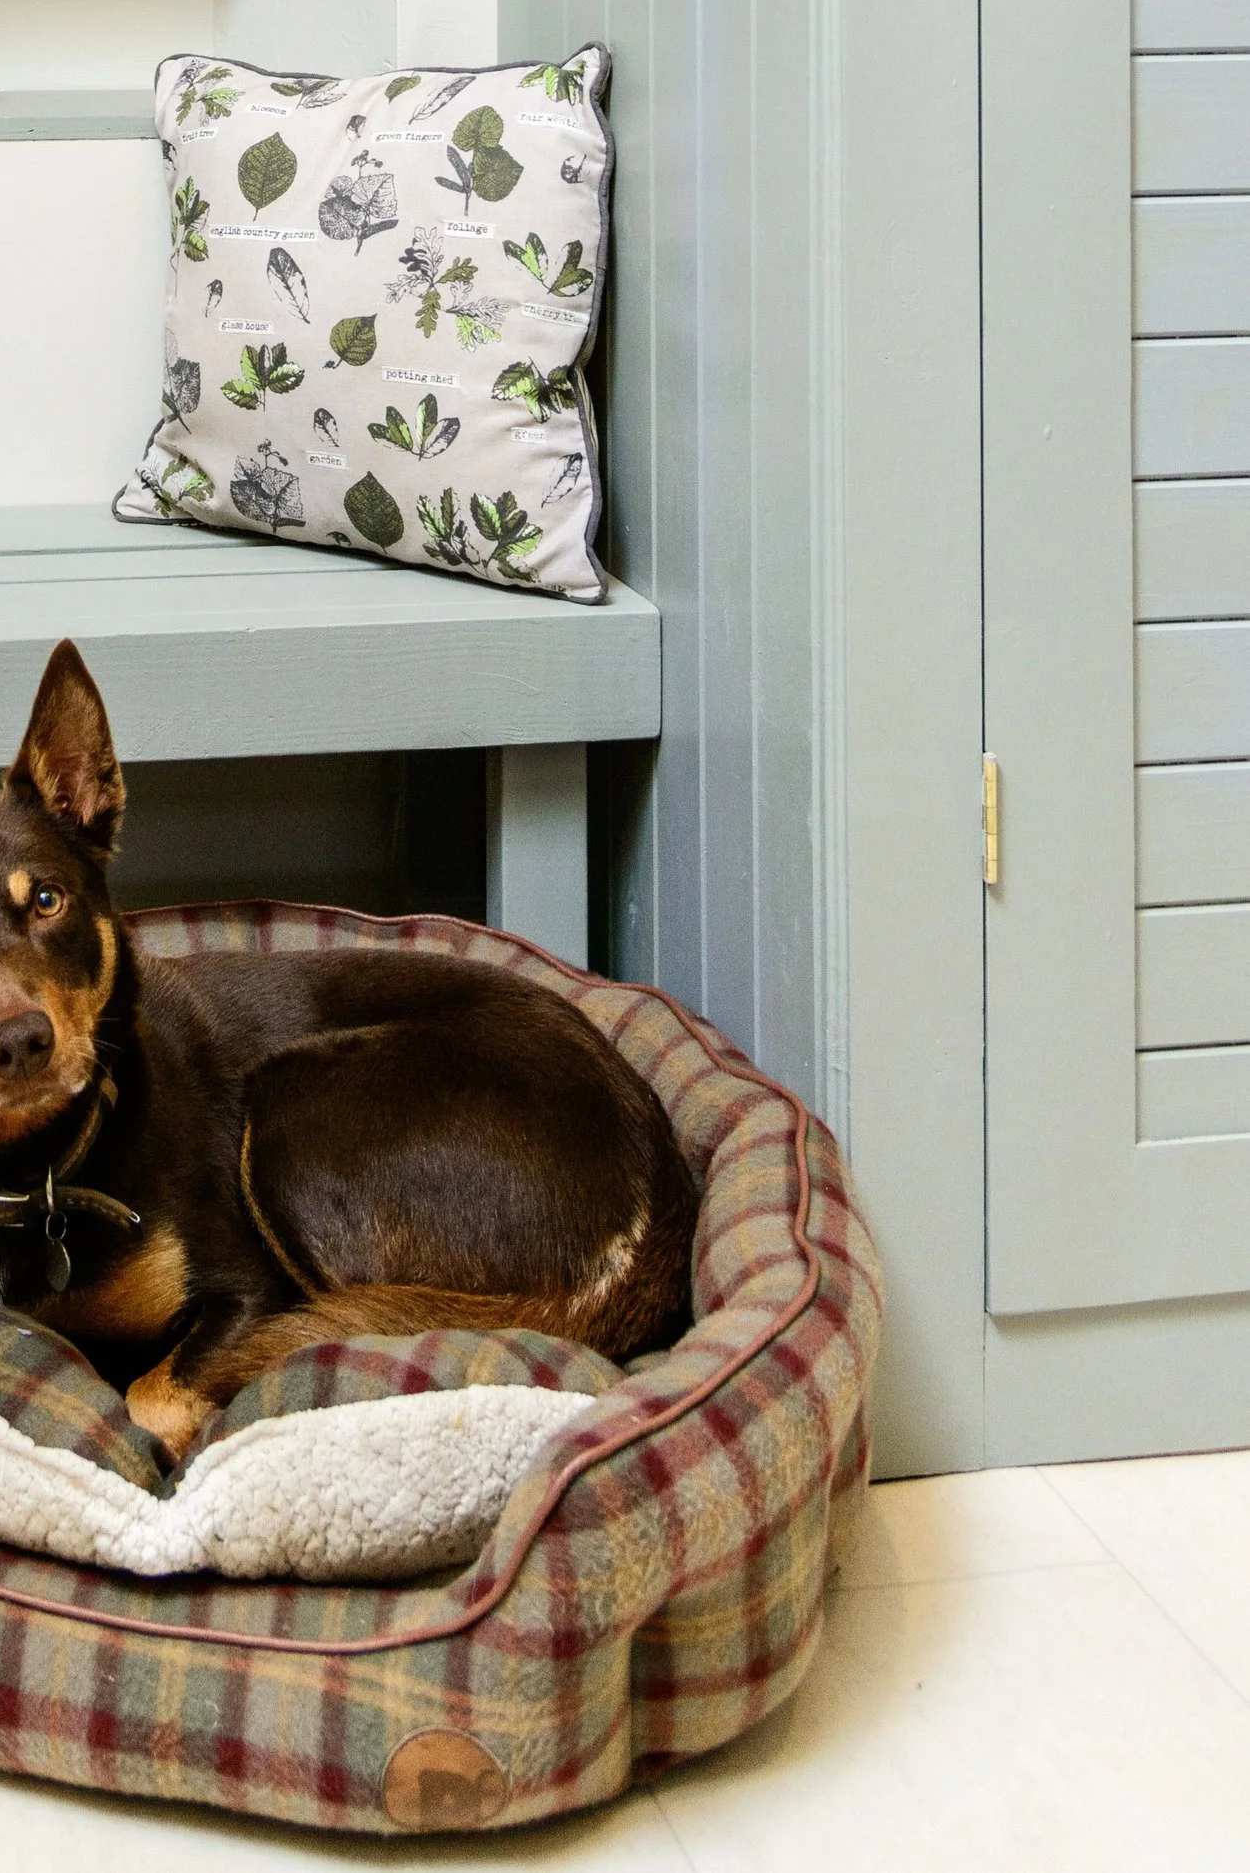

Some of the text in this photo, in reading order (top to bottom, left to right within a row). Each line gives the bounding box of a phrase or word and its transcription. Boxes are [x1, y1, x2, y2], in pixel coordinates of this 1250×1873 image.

[375, 132, 442, 142] green fingers
[210, 227, 315, 240] english country garden
[447, 222, 488, 235] foliage
[524, 305, 560, 320] cherry
[386, 369, 454, 385] potting shed
